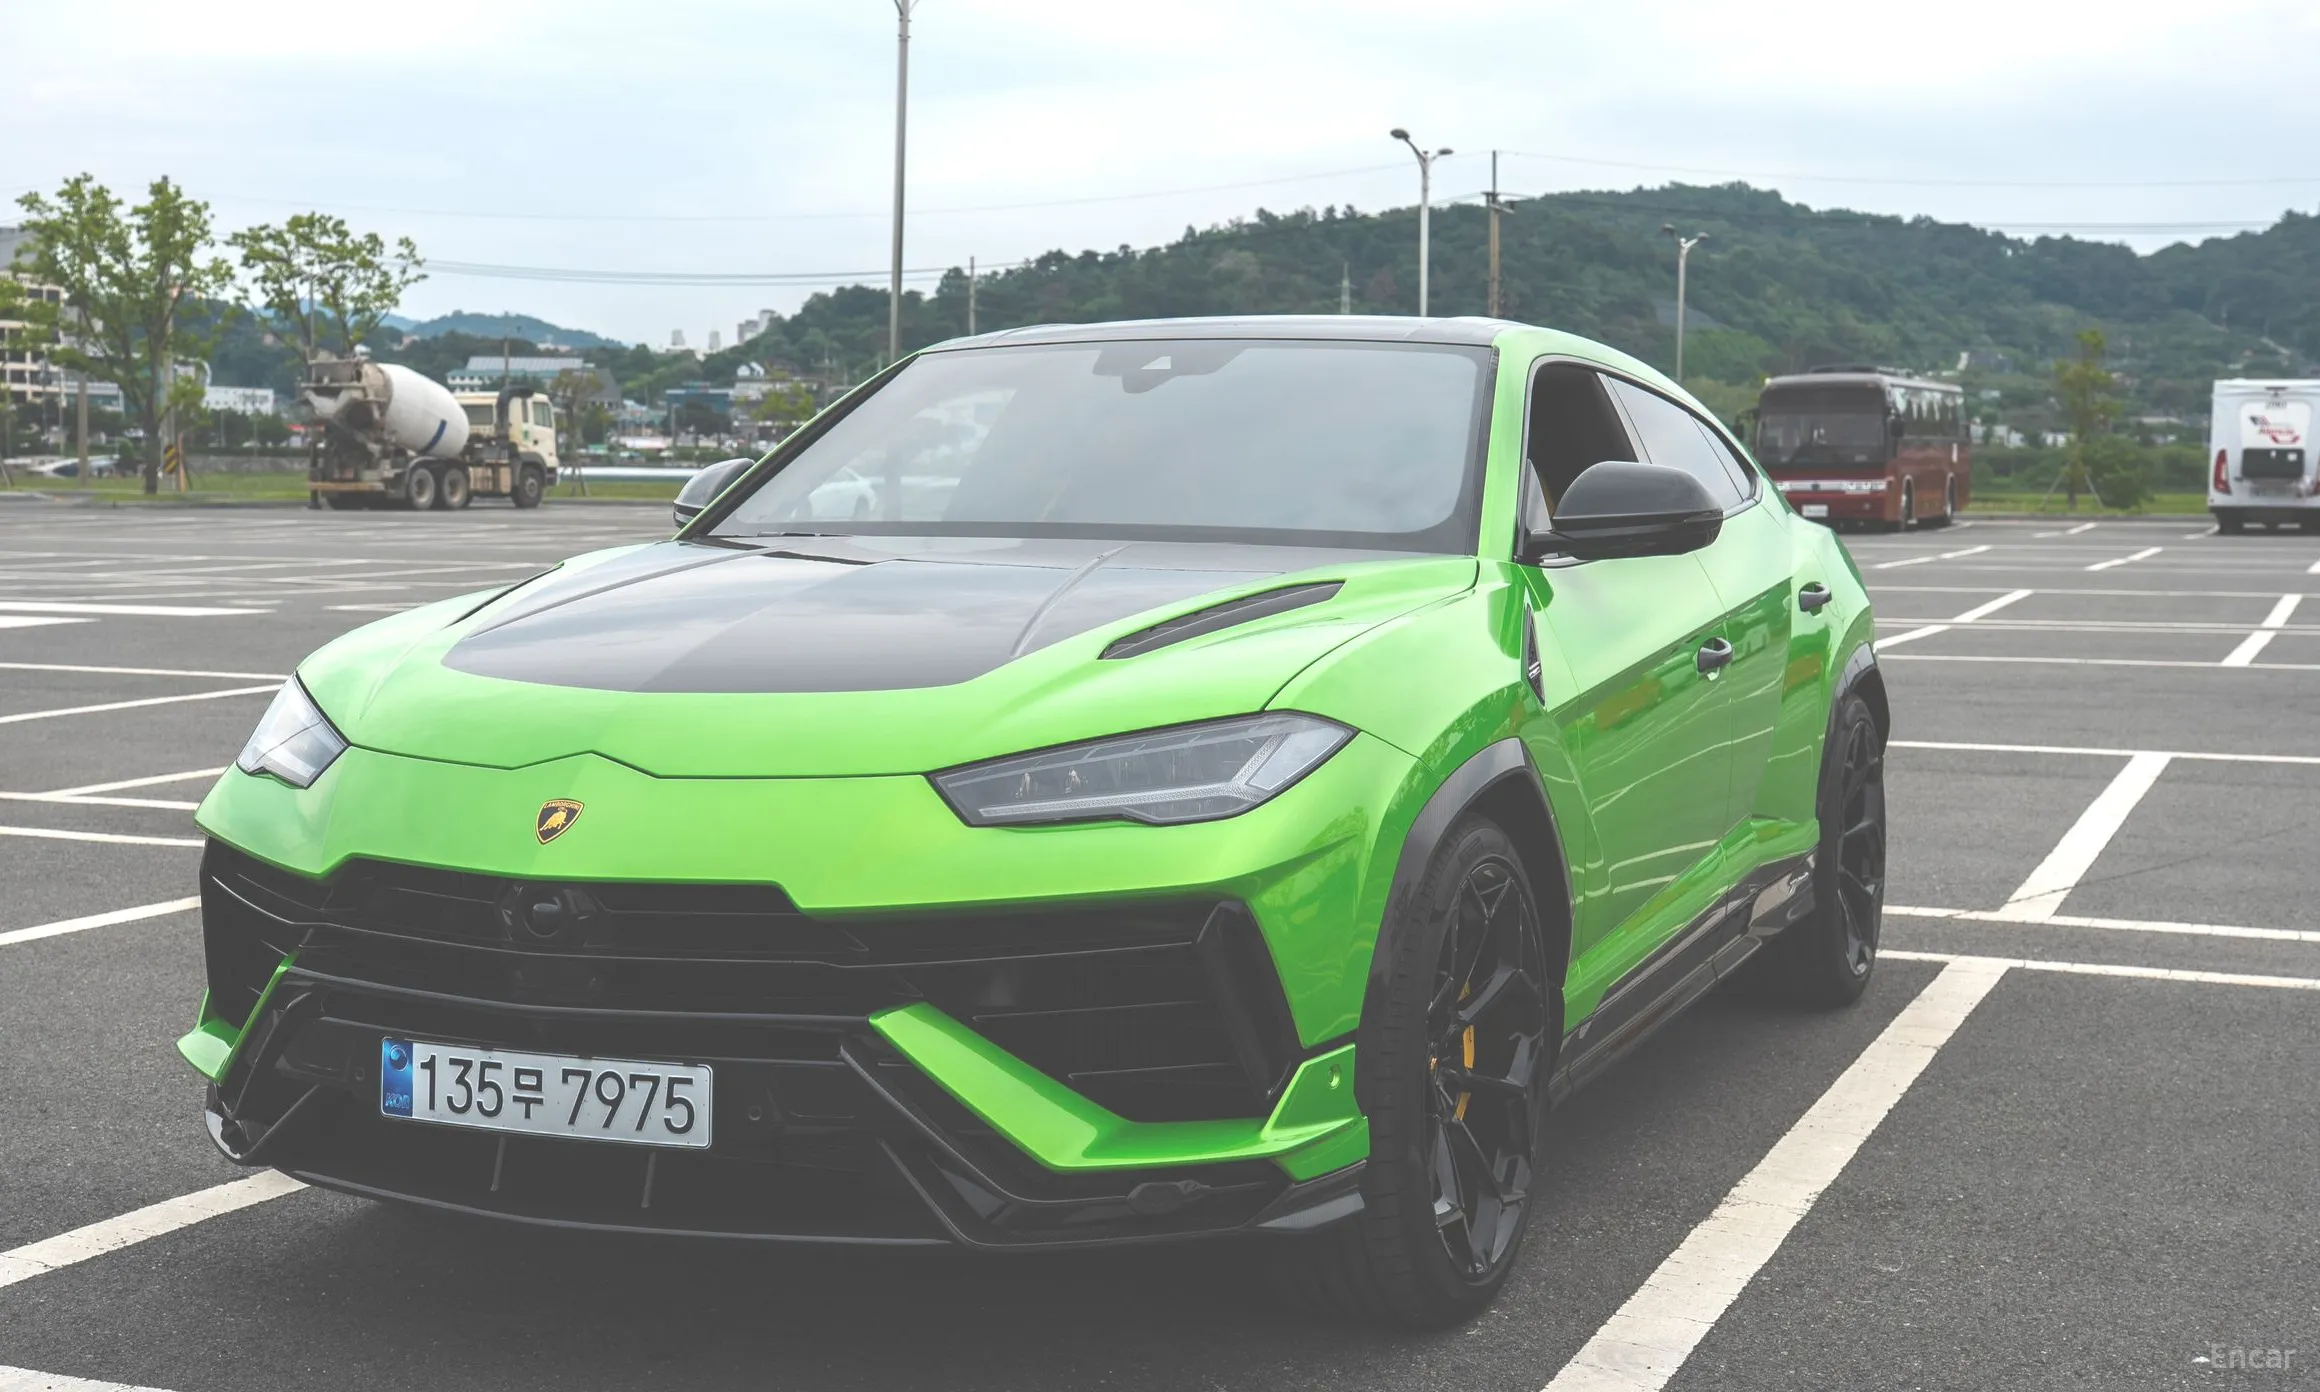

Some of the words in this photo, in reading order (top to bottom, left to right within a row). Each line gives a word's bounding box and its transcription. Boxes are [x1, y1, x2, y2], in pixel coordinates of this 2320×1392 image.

[385, 1092, 411, 1109] KOR
[420, 1054, 544, 1120] 135무
[561, 1068, 695, 1135] 7975
